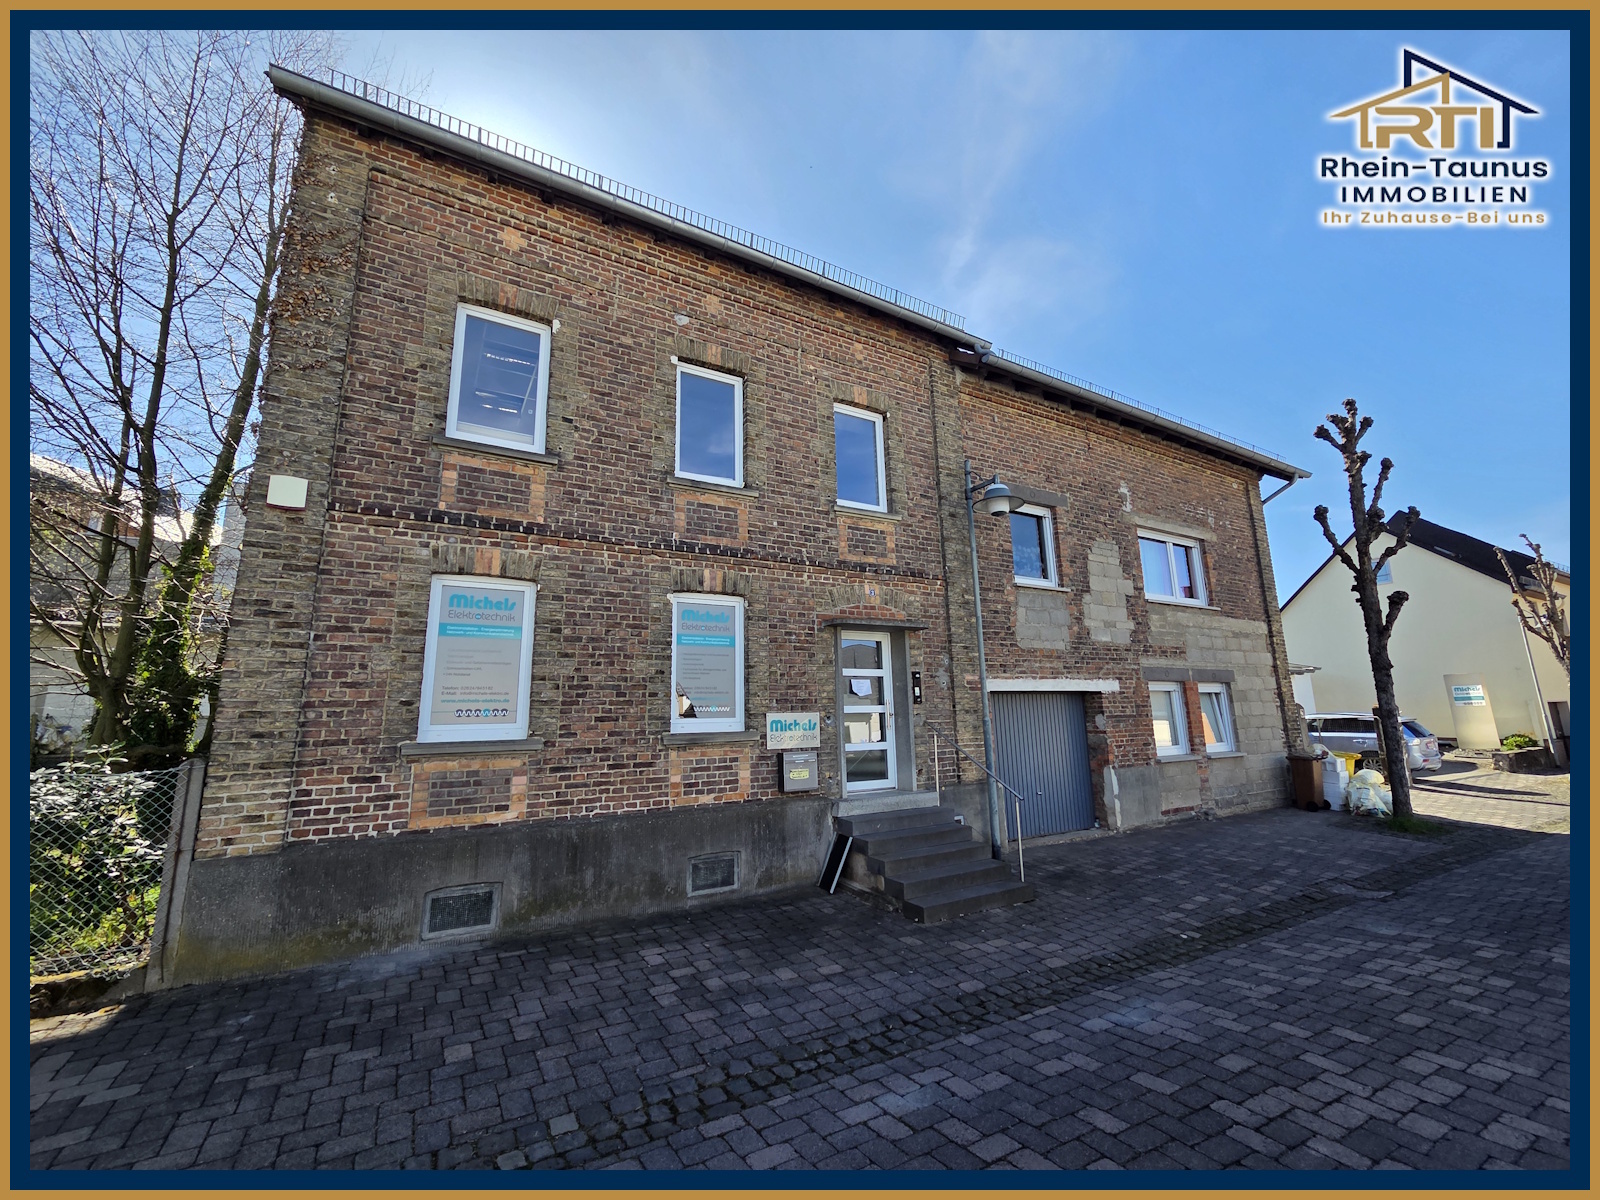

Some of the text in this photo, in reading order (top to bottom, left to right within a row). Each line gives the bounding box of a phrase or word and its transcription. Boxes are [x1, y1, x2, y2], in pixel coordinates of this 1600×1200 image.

[448, 593, 517, 611] Michels
[447, 609, 516, 622] Elektrotechnik
[681, 609, 730, 623] Michels
[681, 622, 730, 632] Elektrotechnik
[770, 718, 817, 732] Michels
[769, 733, 818, 743] Elektrotechnik
